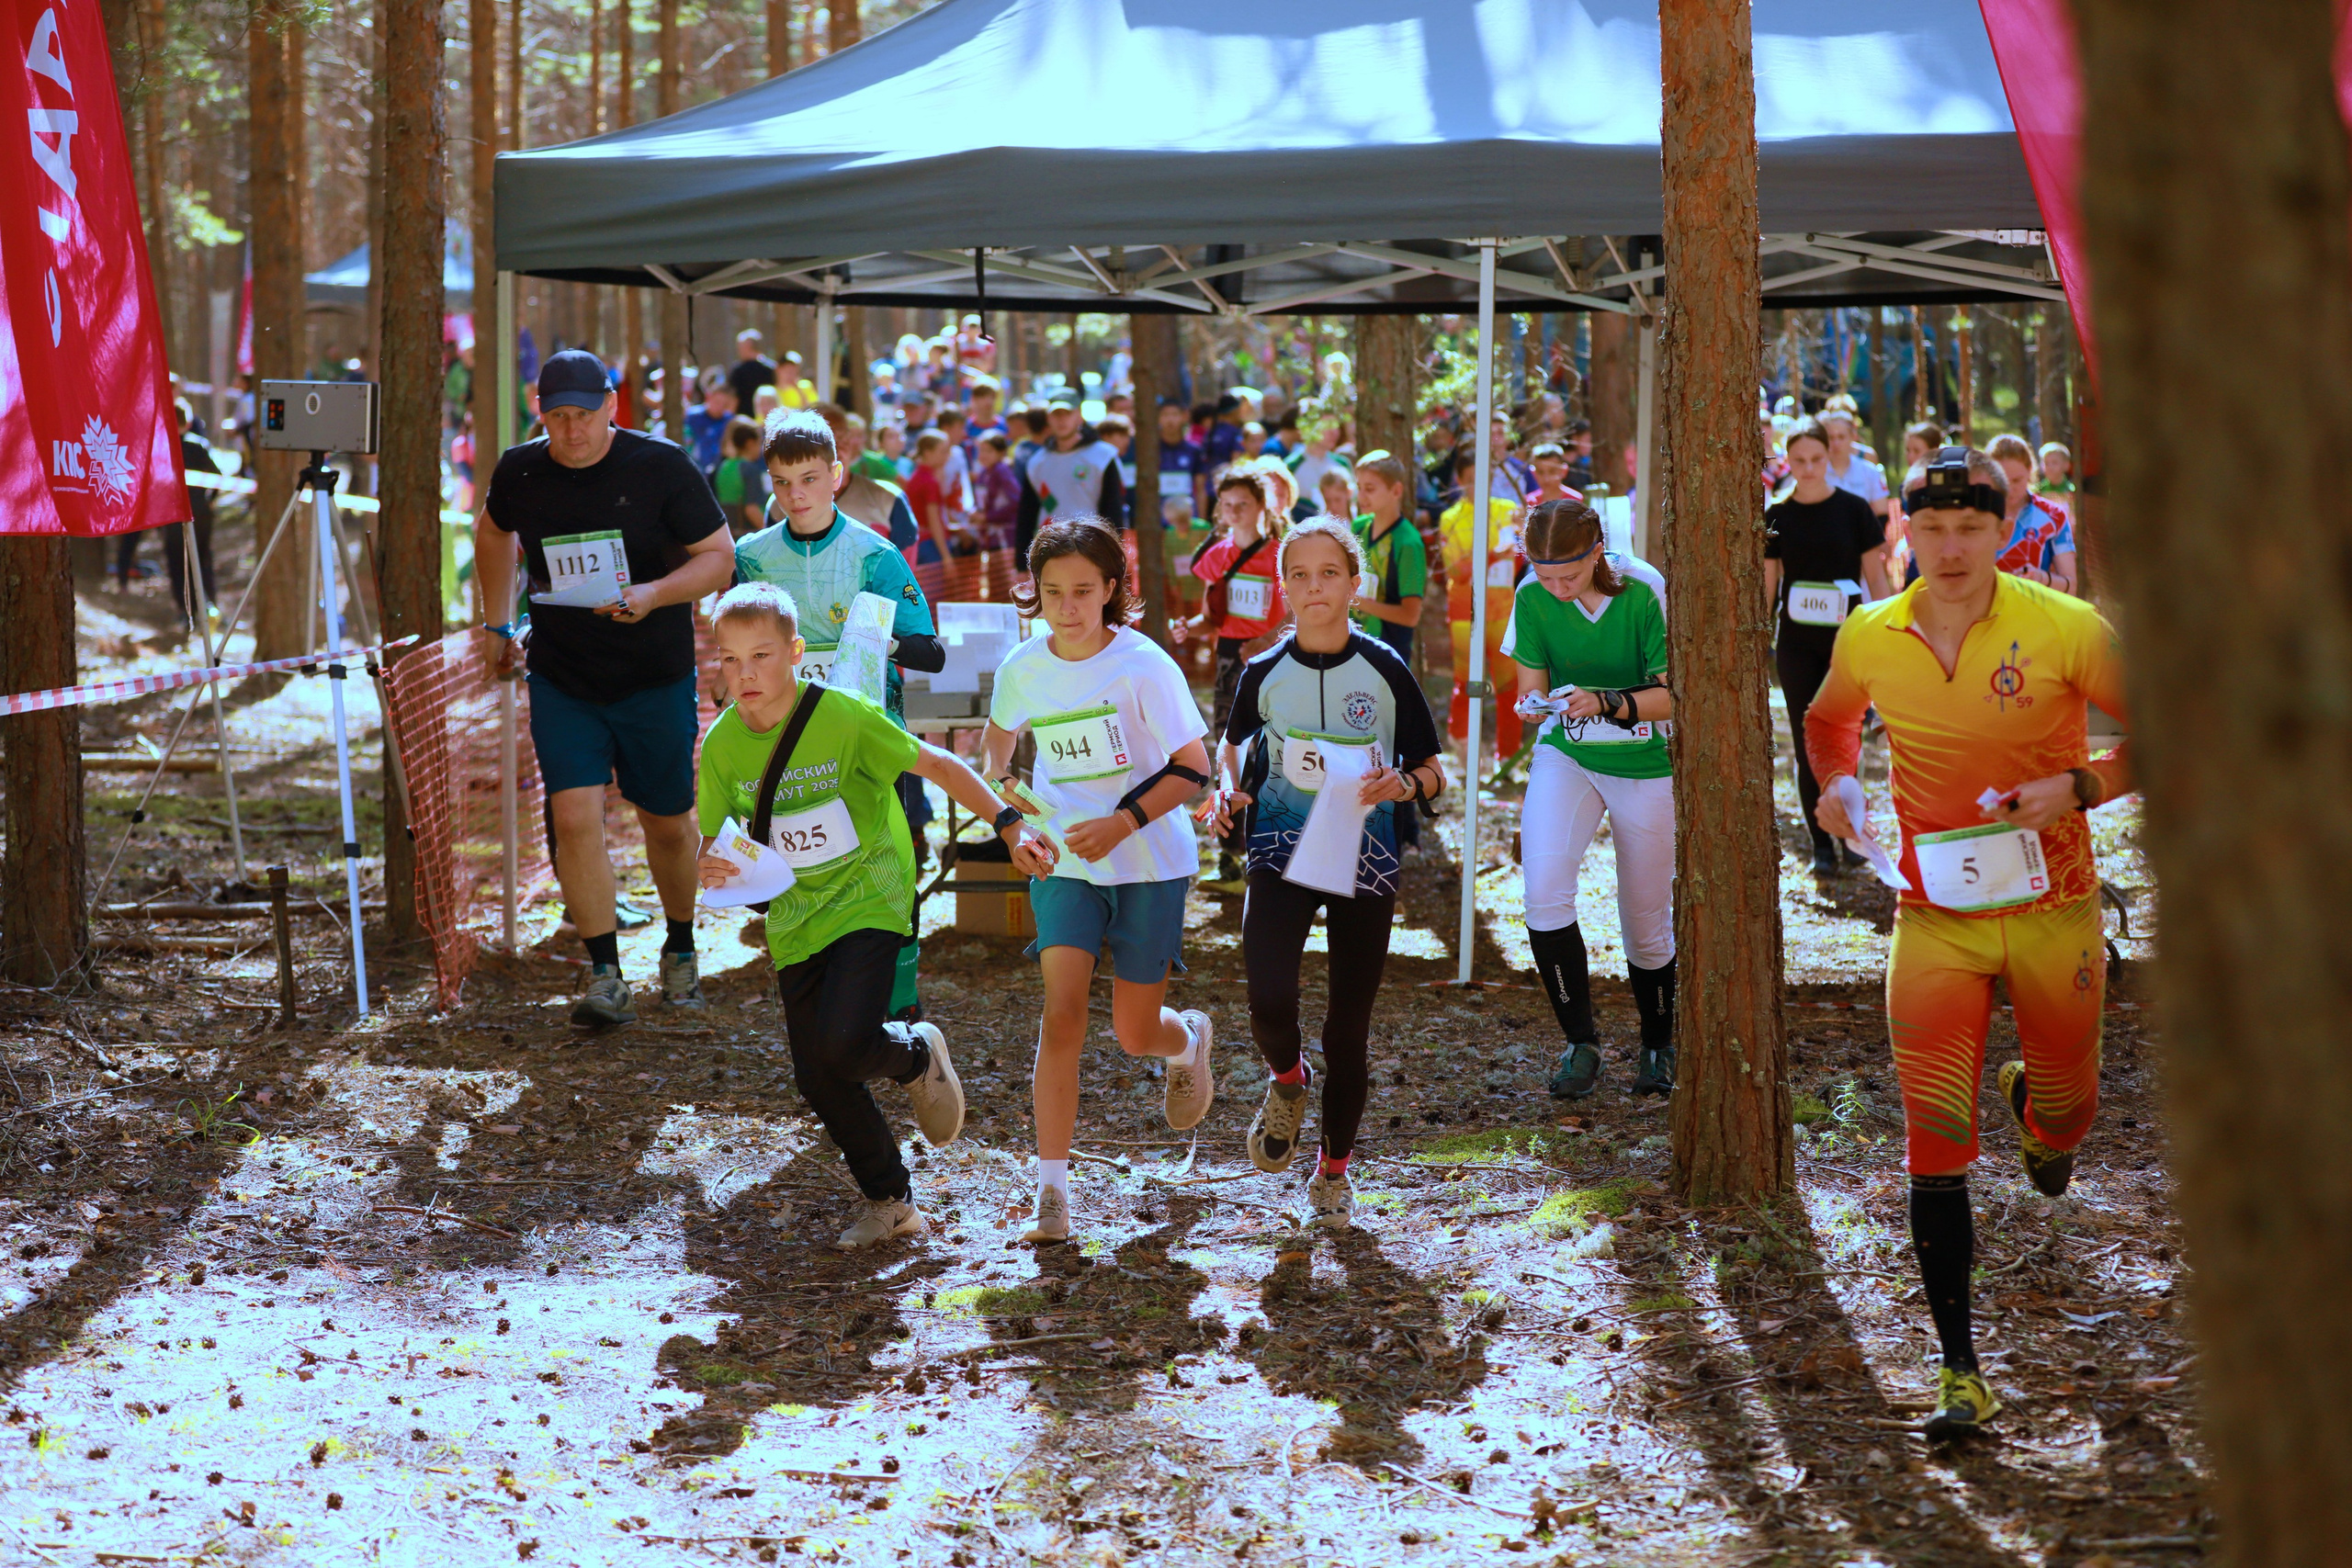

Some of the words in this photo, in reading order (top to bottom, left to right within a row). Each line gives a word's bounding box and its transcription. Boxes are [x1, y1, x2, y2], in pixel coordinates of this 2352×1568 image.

[555, 553, 600, 576] 1112
[1228, 587, 1259, 605] 1013
[1801, 597, 1828, 612] 406
[800, 663, 832, 682] 63
[1342, 691, 1378, 705] ЭДЕЛЬВЕЙС
[2016, 695, 2034, 709] 59
[1102, 718, 1118, 753] ПЕРМСКИЙ
[1112, 725, 1124, 752] ПЕРИОД
[1050, 735, 1091, 761] 944
[781, 824, 828, 852] 825
[1962, 857, 1980, 885] 5
[1555, 964, 1566, 994] NORD
